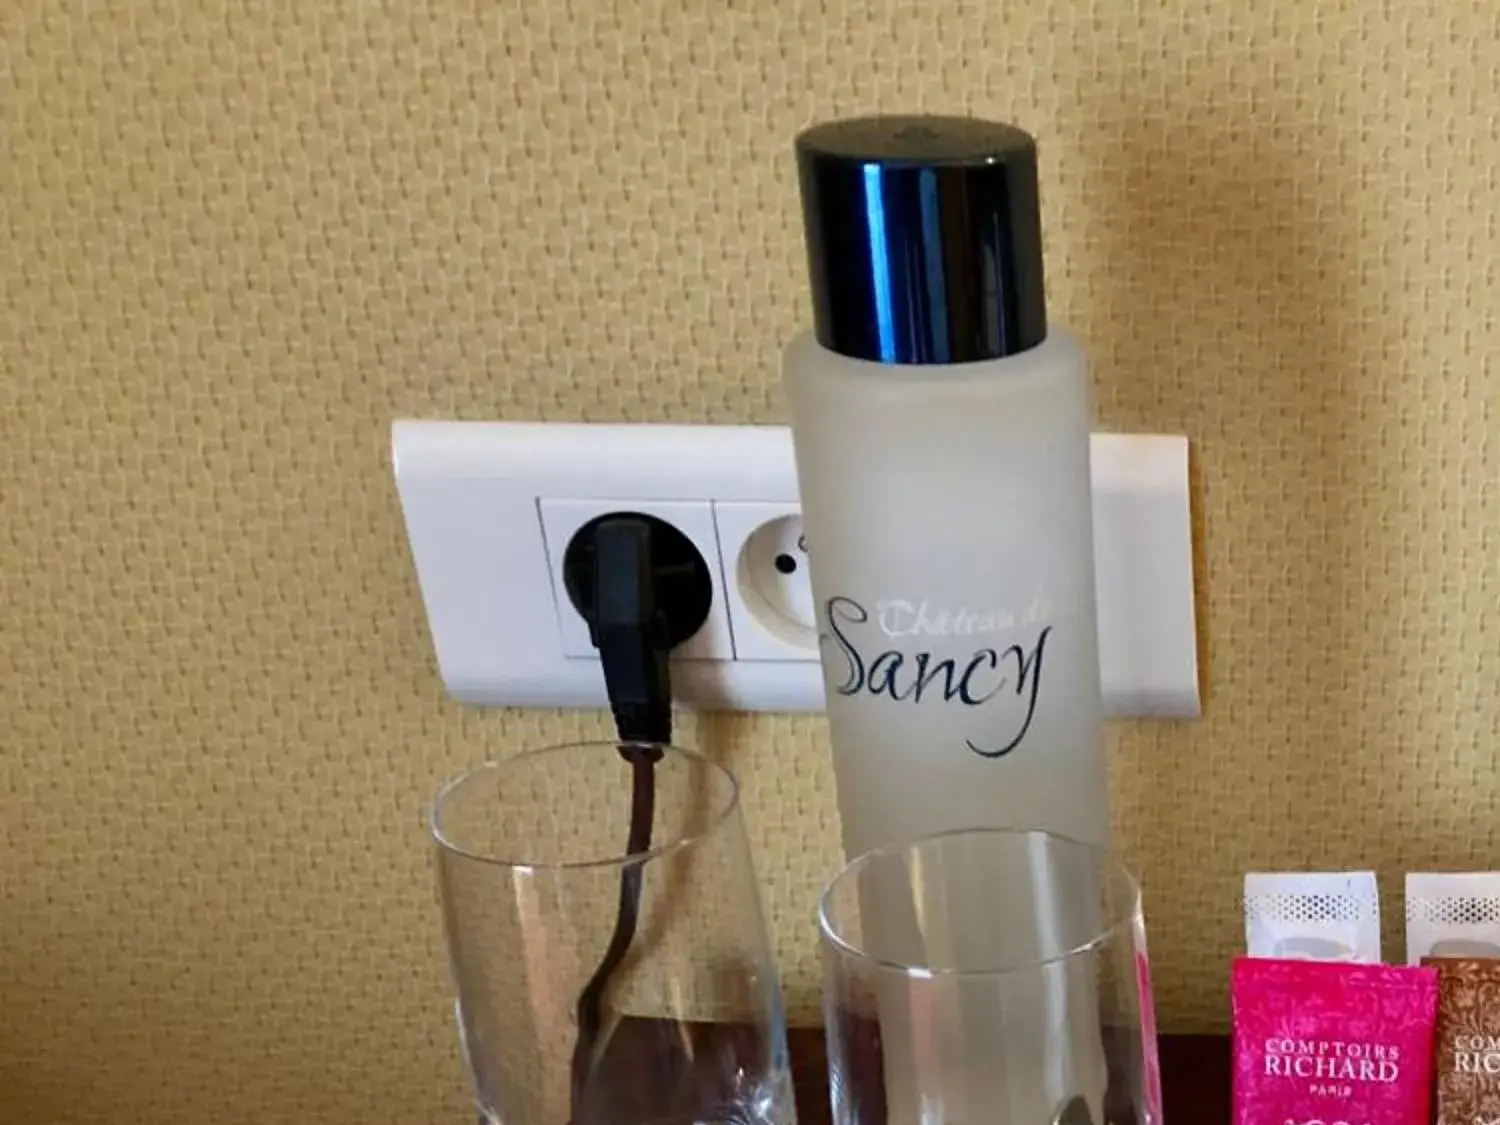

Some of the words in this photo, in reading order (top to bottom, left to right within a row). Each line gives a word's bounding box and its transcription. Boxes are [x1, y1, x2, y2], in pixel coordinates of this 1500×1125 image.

[820, 596, 1052, 758] Sancy
[1265, 1037, 1399, 1061] COMPTOIRS
[1264, 1053, 1399, 1082] RICHARD
